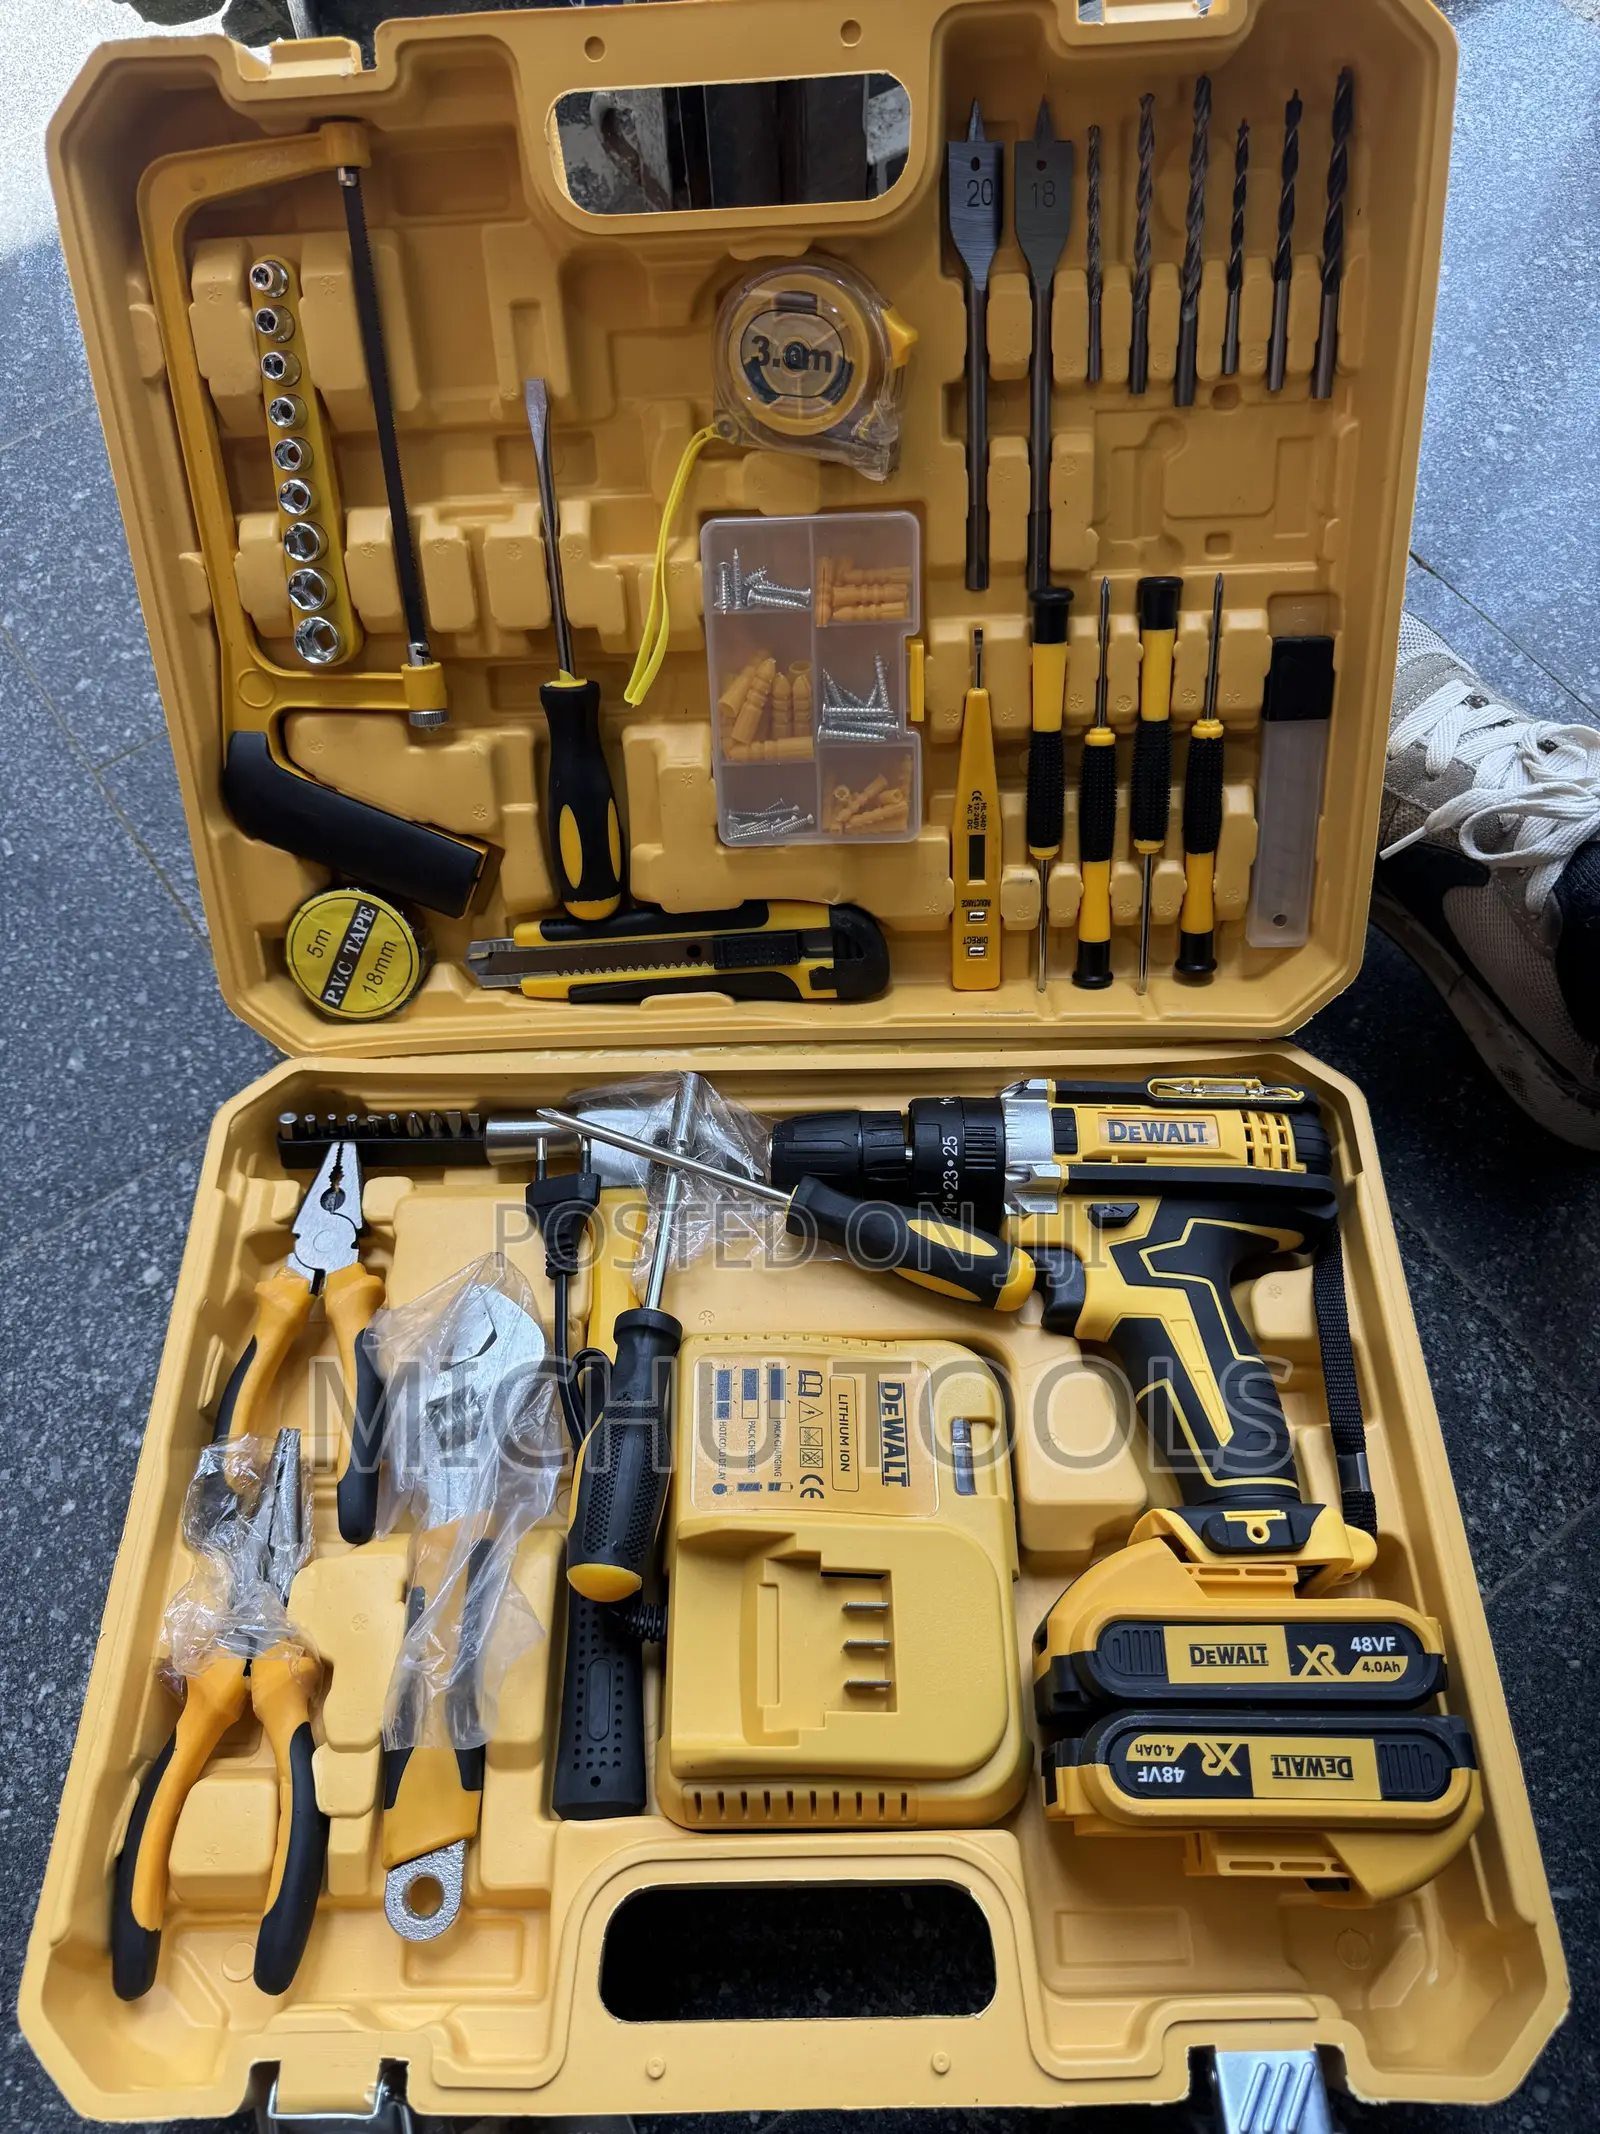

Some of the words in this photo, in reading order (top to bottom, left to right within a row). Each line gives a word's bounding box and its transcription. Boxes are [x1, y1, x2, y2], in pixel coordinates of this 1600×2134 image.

[966, 178, 993, 207] 20
[1031, 180, 1056, 209] 18
[750, 335, 832, 373] 3.m
[967, 803, 972, 814] AC
[967, 819, 972, 830] DC
[306, 928, 332, 958] 5m
[343, 905, 377, 955] TAPE
[962, 935, 988, 944] DIRECT
[362, 940, 398, 995] 18mm
[748, 1420, 756, 1439] PACK
[774, 1420, 782, 1439] PACK
[838, 1394, 850, 1445] LITHIUM
[718, 1458, 727, 1480] DELAY
[748, 1439, 756, 1473] CHERGER
[774, 1439, 783, 1477] CHARGING
[840, 1449, 850, 1472] ION
[1350, 1636, 1397, 1652] 48VF
[1297, 1644, 1343, 1676] XR
[1362, 1660, 1401, 1674] 4.0Ah
[1134, 1743, 1175, 1757] 4.0Ah
[1201, 1743, 1241, 1776] XR
[1137, 1766, 1186, 1783] 48VF
